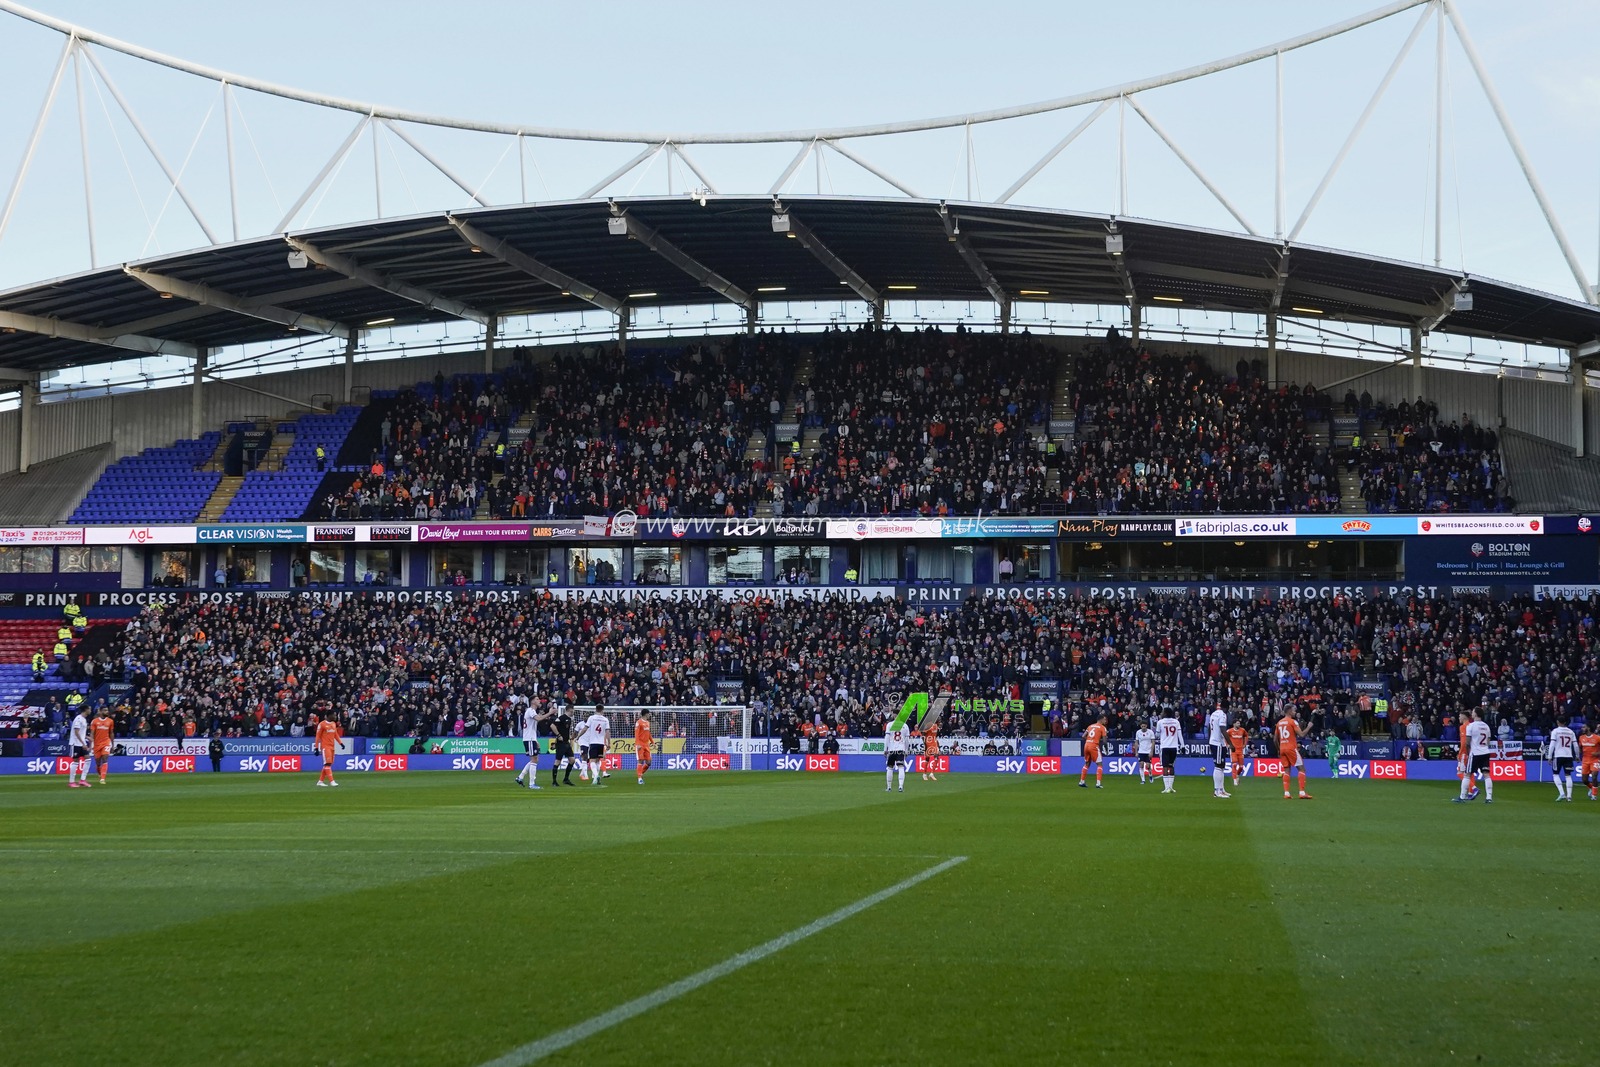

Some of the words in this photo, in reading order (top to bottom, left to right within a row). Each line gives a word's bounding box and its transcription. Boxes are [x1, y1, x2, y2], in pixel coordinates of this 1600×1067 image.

[533, 527, 552, 536] CARRS
[552, 527, 577, 538] Pasties
[1058, 519, 1091, 536] Nam
[1092, 519, 1119, 537] Ploy
[1120, 523, 1172, 531] NAMPLOY.CO.UK
[1196, 521, 1289, 535] fabriplas.co.uk
[1342, 521, 1371, 531] SMYTHS
[199, 531, 234, 540] CLEAR
[237, 530, 275, 540] VISION
[420, 527, 443, 540] David
[442, 526, 461, 540] Lloyd
[1489, 543, 1531, 551] BOLTON
[302, 592, 354, 603] PRINT
[375, 591, 453, 603] PROCESS
[476, 591, 520, 603] POST
[566, 590, 662, 602] FRANKING
[734, 589, 794, 601] SOUTH
[803, 589, 862, 602] STAND
[908, 588, 962, 601] PRINT
[986, 587, 1066, 600] PROCESS
[1091, 587, 1137, 600] POST
[1151, 587, 1187, 595] FRANKING
[1200, 586, 1255, 599] PRINT
[1279, 586, 1363, 599] PROCESS
[25, 594, 78, 606] PRINT
[99, 593, 177, 605] PROCESS
[200, 592, 244, 604] POST
[595, 723, 602, 734] 4
[1088, 729, 1095, 738] 6
[1164, 725, 1176, 737] 19
[1278, 726, 1290, 738] 16
[894, 731, 901, 742] 8
[1479, 733, 1487, 745] 2
[1560, 735, 1571, 747] 12
[140, 746, 207, 755] MORTGAGES
[225, 743, 310, 753] Communications
[1368, 747, 1390, 755] cowgills
[27, 758, 55, 774] sky
[133, 756, 161, 773] sky
[165, 758, 191, 770] bet
[240, 756, 267, 772] sky
[271, 758, 298, 770] bet
[346, 756, 373, 771] sky
[378, 757, 404, 769] bet
[453, 755, 480, 771] sky
[484, 757, 511, 769] bet
[667, 755, 695, 771] sky
[700, 757, 728, 769] bet
[776, 755, 803, 771] sky
[809, 757, 836, 769] bet
[996, 757, 1024, 774] sky
[1030, 759, 1057, 772] bet
[1109, 757, 1137, 775] sky
[1223, 759, 1251, 777] sy
[1339, 760, 1367, 778] sky
[1373, 761, 1402, 776] bet
[1493, 762, 1522, 777] bet
